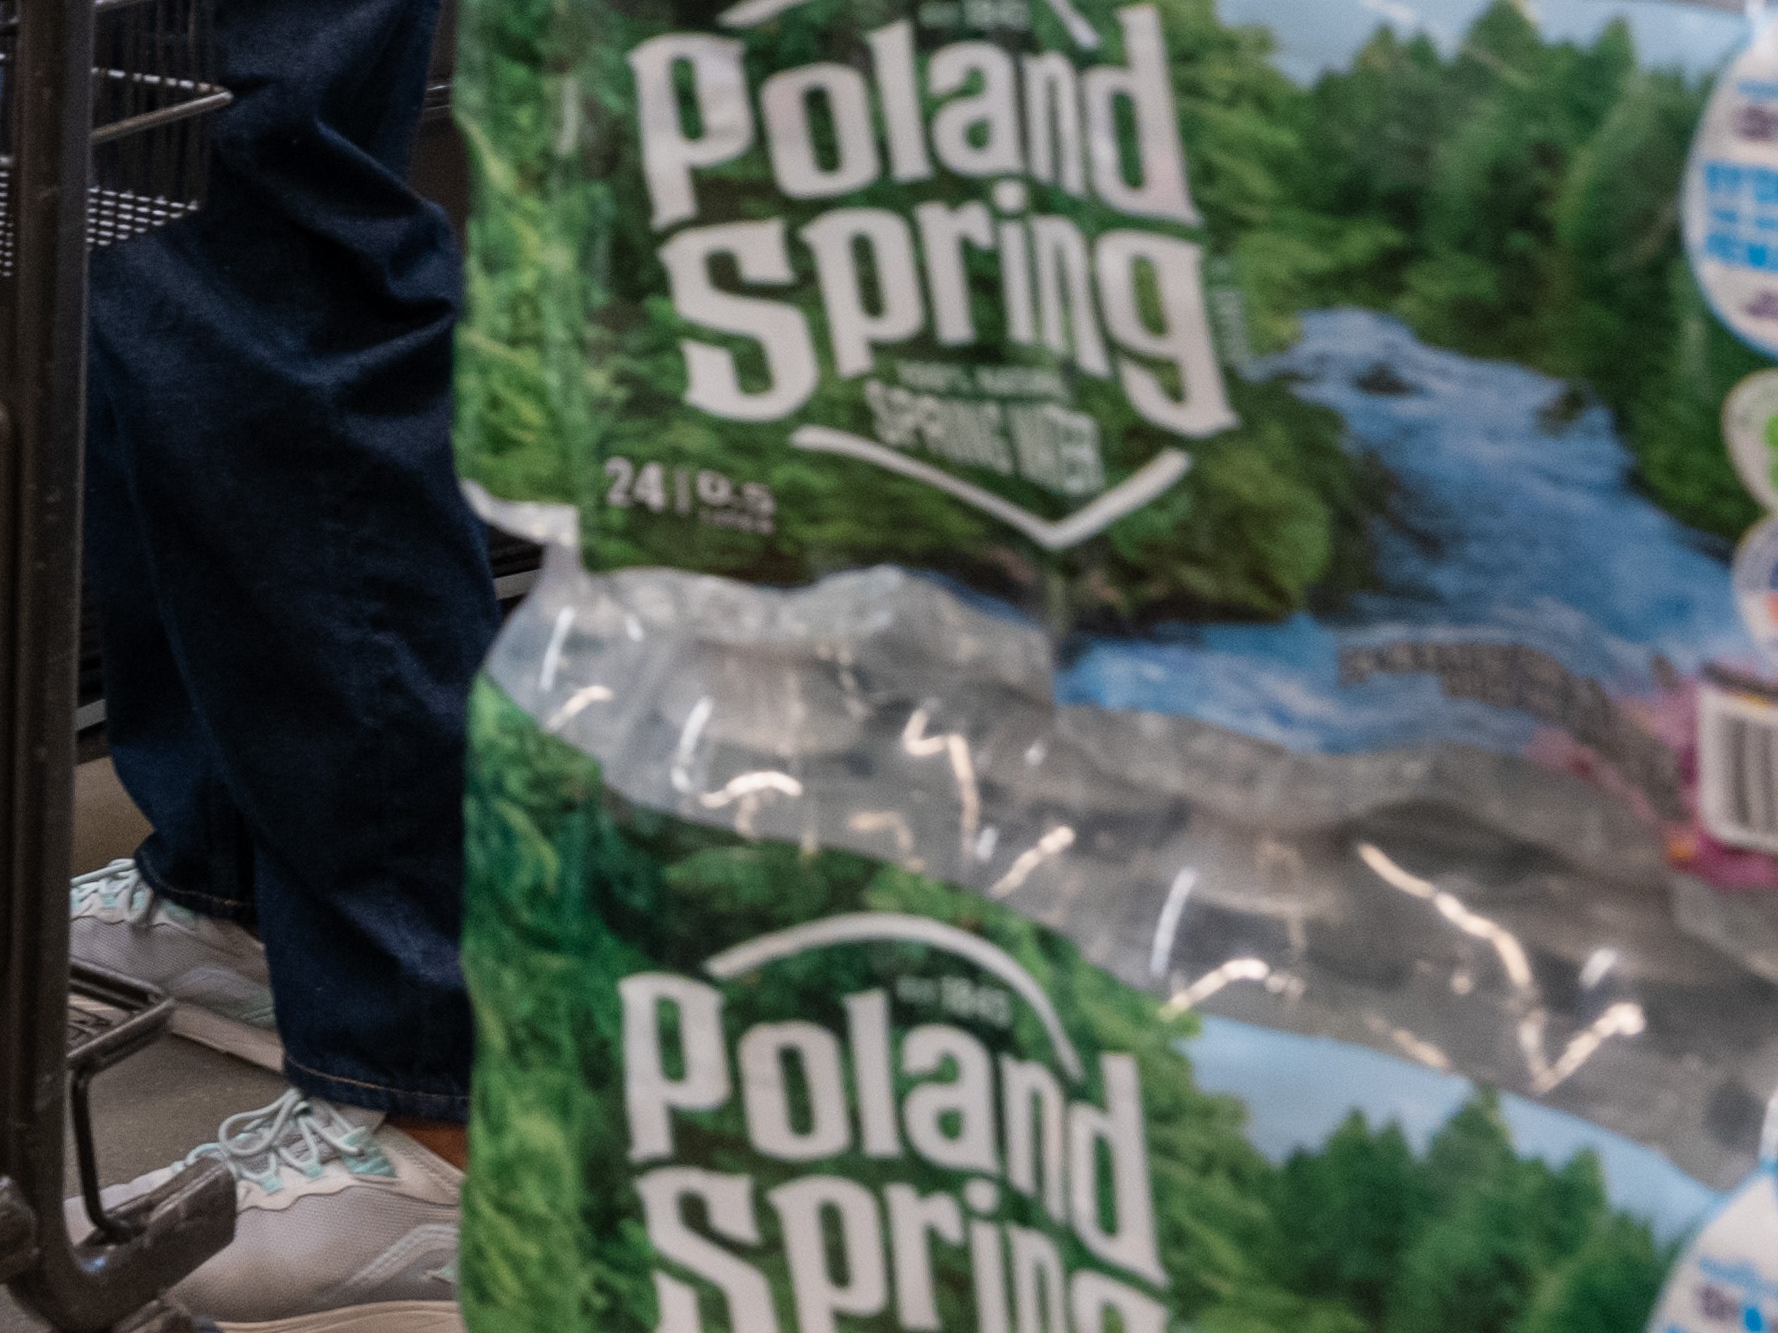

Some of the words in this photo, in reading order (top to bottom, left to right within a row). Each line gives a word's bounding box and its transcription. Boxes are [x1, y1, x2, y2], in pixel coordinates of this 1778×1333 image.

[627, 3, 1203, 231] Poland
[658, 182, 1242, 437] Spring
[603, 457, 666, 513] 24
[617, 970, 1169, 1288] Poland
